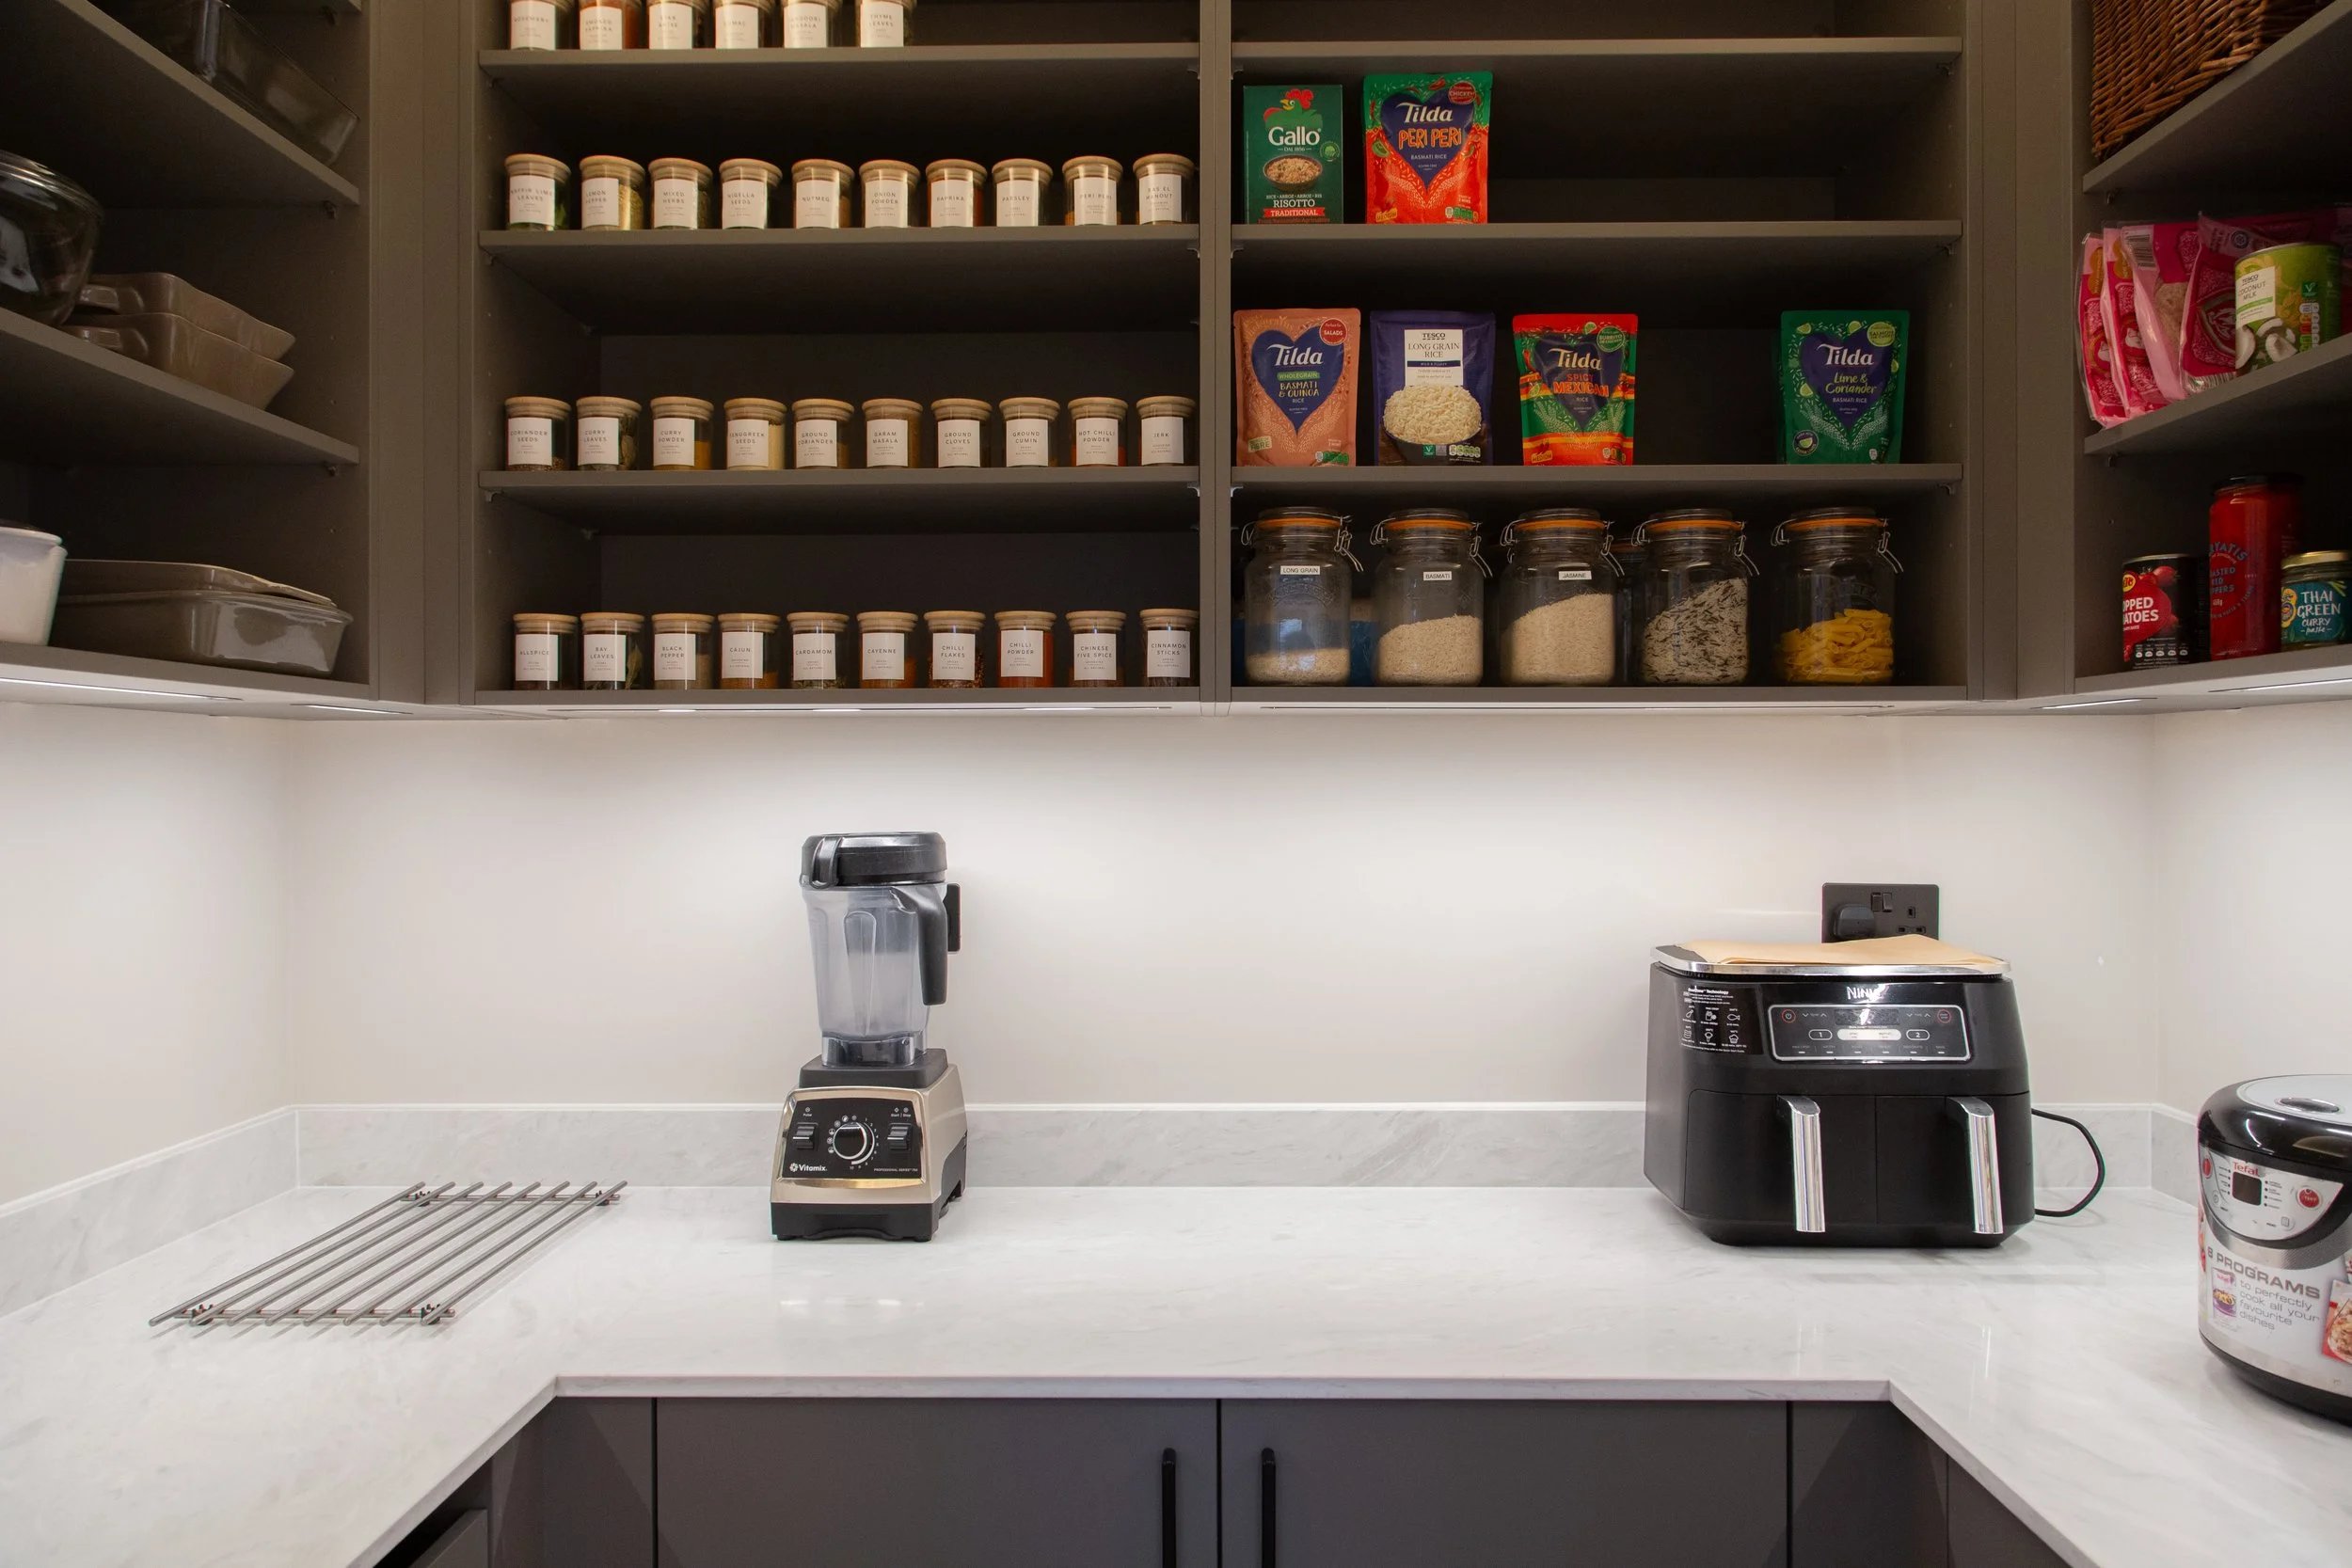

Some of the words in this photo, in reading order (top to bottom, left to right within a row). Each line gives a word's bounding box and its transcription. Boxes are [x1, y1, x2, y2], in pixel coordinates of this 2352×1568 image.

[1394, 102, 1454, 123] Tilda
[1267, 125, 1321, 147] Gallo
[1398, 128, 1428, 150] PERI
[1430, 127, 1462, 148] PERI
[1273, 199, 1315, 208] RISOTTO
[1270, 209, 1319, 217] TRADITIONAL
[2238, 279, 2266, 297] COCONUT
[2243, 291, 2258, 300] MILK
[1407, 342, 1430, 351] LONG
[1432, 342, 1460, 351] GRAIN
[1816, 342, 1875, 367] Tilda
[1265, 343, 1324, 367] Tilda
[1547, 348, 1602, 371] Tilda
[1279, 381, 1318, 390] BASMATI
[1566, 373, 1594, 382] SPICY
[1834, 372, 1859, 384] Lime
[1859, 372, 1868, 383] &
[1287, 388, 1320, 398] QUINOA
[1552, 381, 1610, 398] MEXICAN
[1825, 381, 1878, 396] Coriander
[2299, 590, 2334, 604] THAI
[2296, 603, 2342, 619] GREEN
[2301, 618, 2331, 627] CURRY
[799, 1164, 827, 1172] Vitamix
[2233, 1161, 2259, 1177] Tefal
[2206, 1245, 2215, 1259] 8
[2216, 1251, 2321, 1301] PROGRAMS
[2240, 1278, 2251, 1291] to
[2254, 1286, 2312, 1312] perfectly
[2240, 1290, 2265, 1307] cook
[2269, 1302, 2283, 1312] all
[2287, 1307, 2321, 1323] your
[2240, 1299, 2293, 1326] favourite
[2239, 1309, 2276, 1331] dishes
